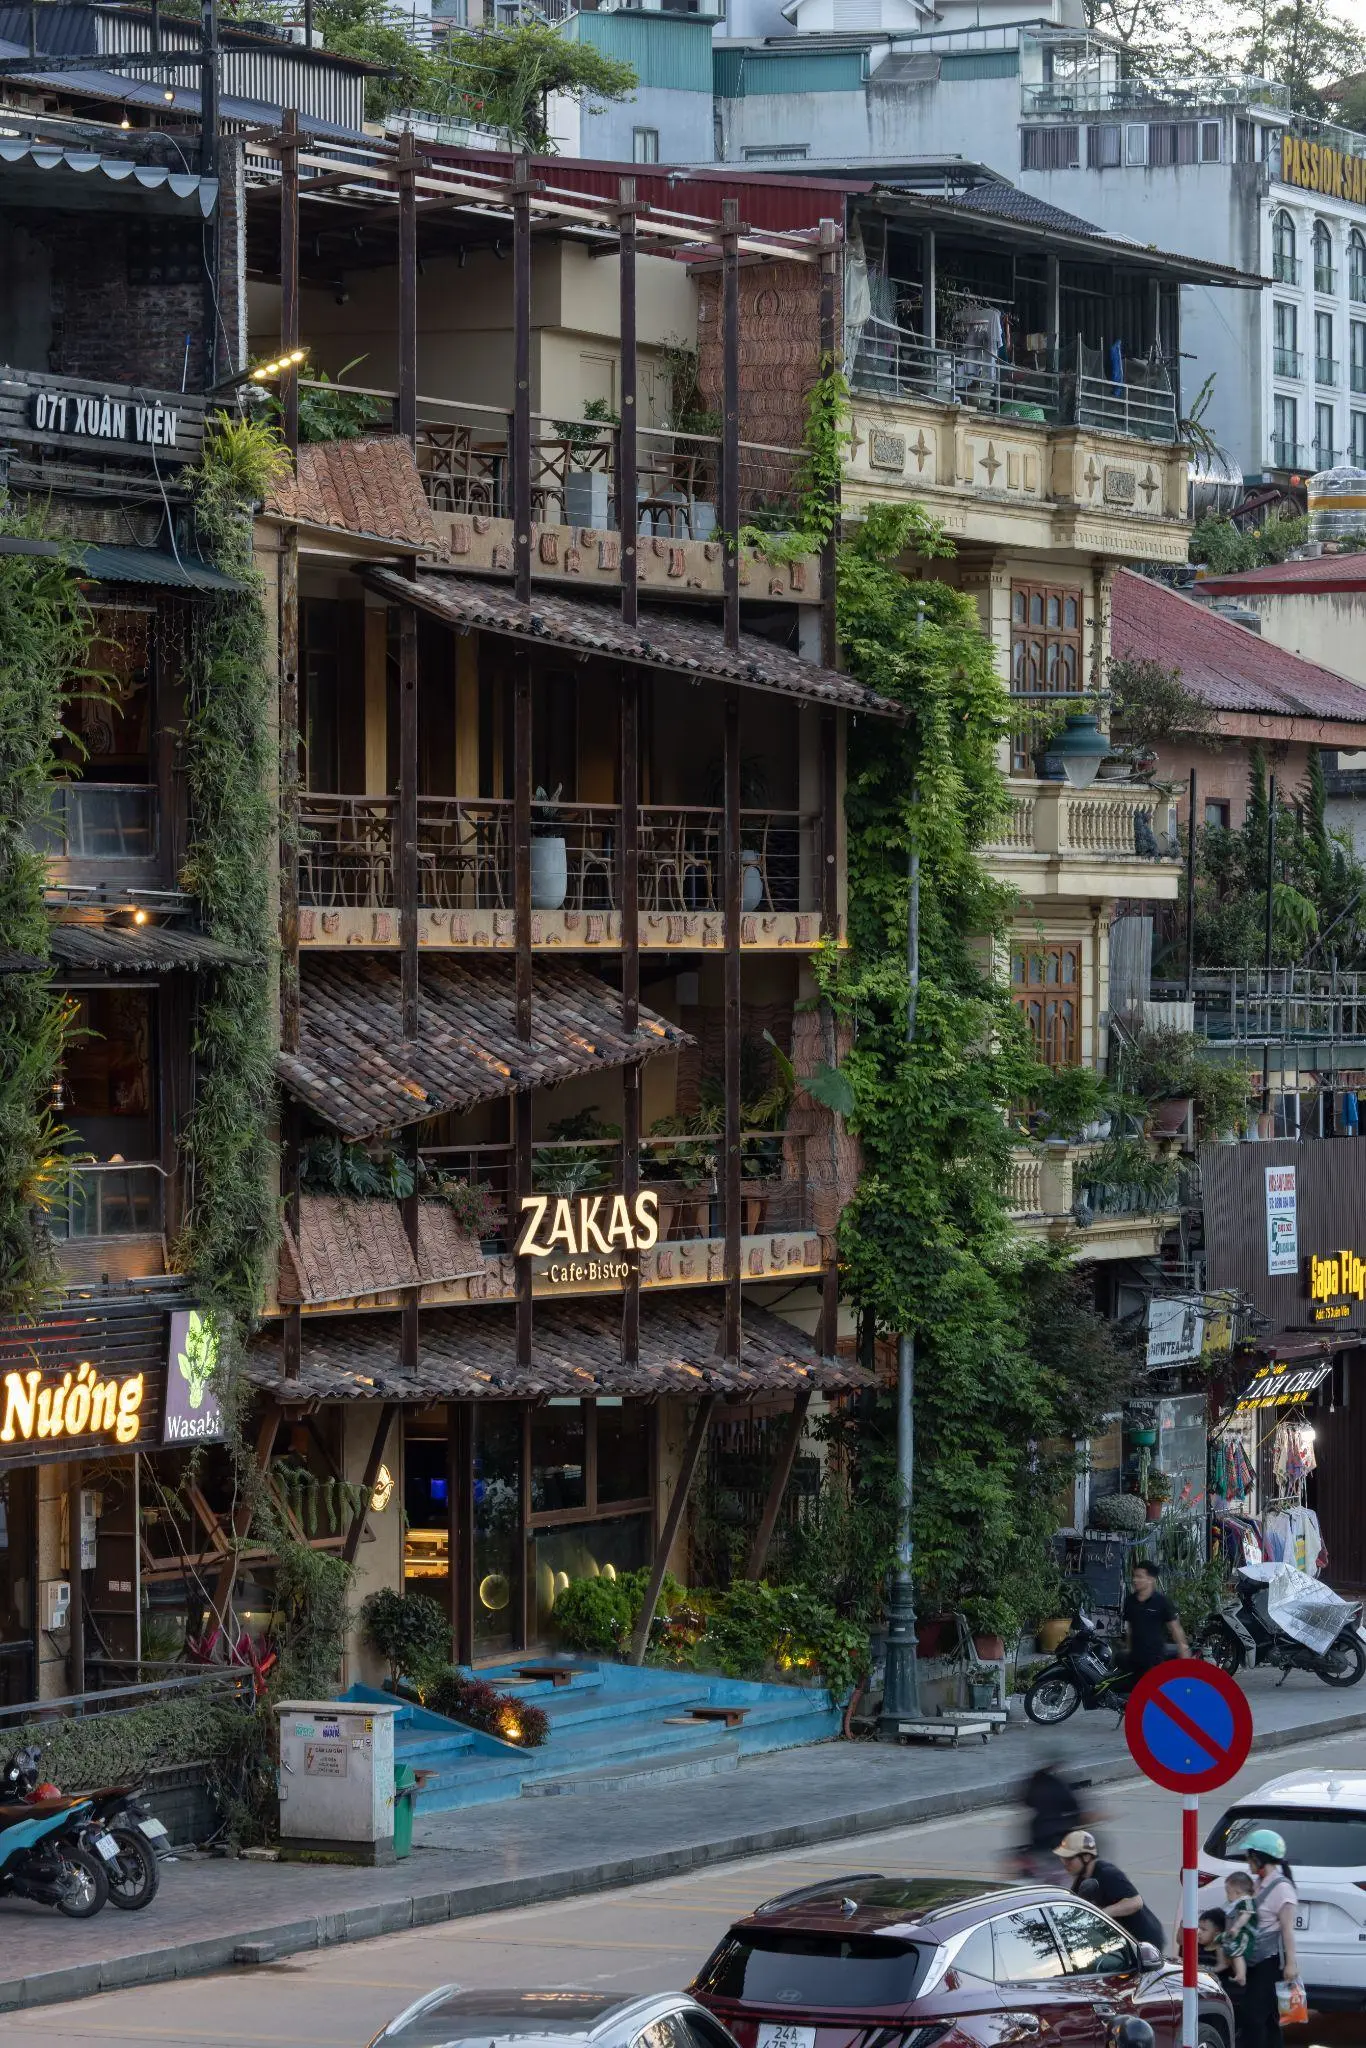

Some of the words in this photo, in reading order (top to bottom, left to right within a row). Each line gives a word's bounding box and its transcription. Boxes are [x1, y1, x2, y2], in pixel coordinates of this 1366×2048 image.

[1283, 136, 1343, 199] PASSION
[36, 393, 67, 432] 071
[74, 394, 126, 439] XUÂN
[135, 399, 177, 446] VIÊN
[519, 1190, 658, 1257] ZAKAS
[1311, 1254, 1339, 1304] Sapa
[1, 1362, 143, 1443] Nướng
[1283, 1362, 1333, 1393] CHÂU
[167, 1410, 220, 1439] Wasabi
[774, 2026, 797, 2040] 24A
